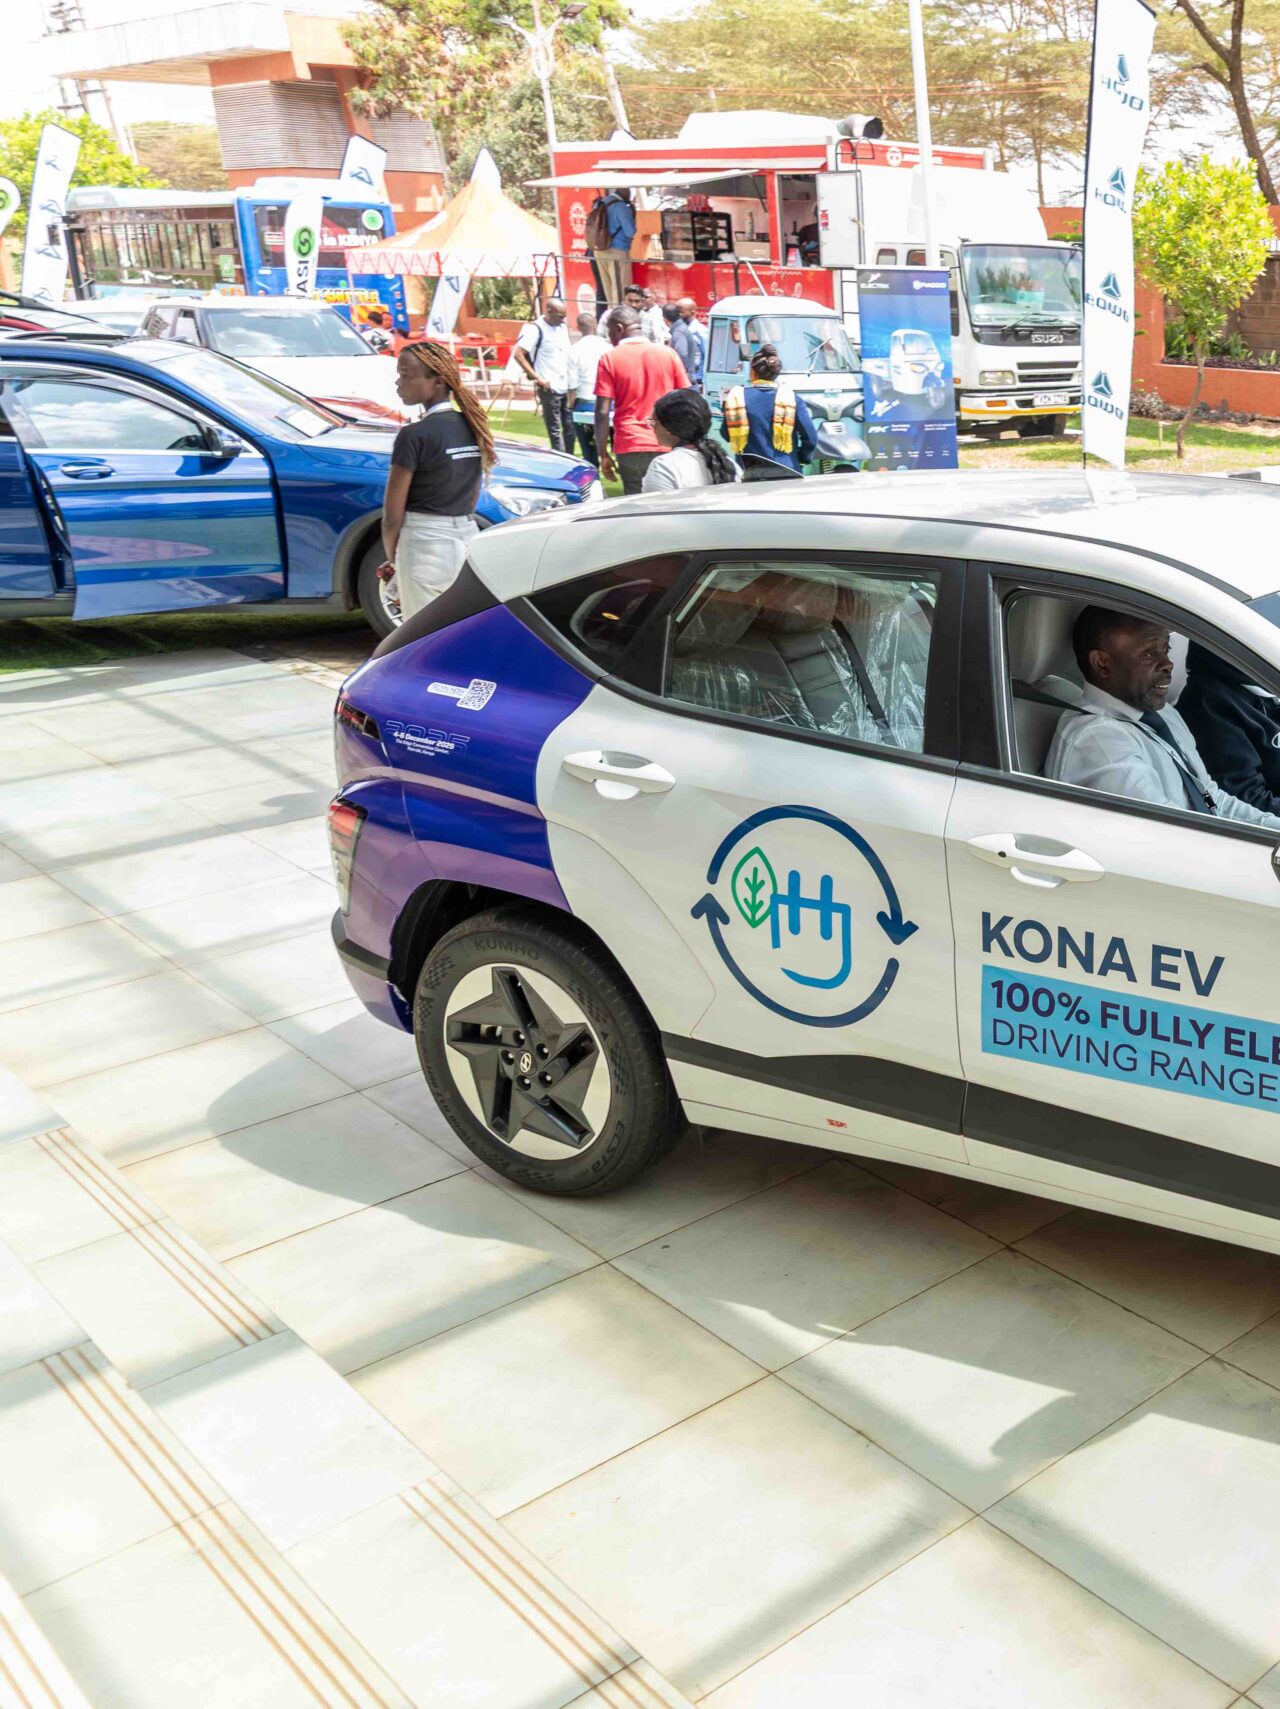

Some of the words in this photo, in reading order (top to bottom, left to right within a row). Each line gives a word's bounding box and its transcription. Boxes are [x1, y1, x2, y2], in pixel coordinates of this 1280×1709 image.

[1031, 334, 1064, 344] ISUZU
[473, 938, 541, 960] KUMHO
[981, 911, 1138, 983] KONA
[1151, 944, 1225, 997] EV
[991, 980, 1091, 1025] 100%
[1100, 1000, 1216, 1049] FULLY
[992, 1019, 1138, 1073] DRIVING
[1150, 1050, 1278, 1103] RANGE
